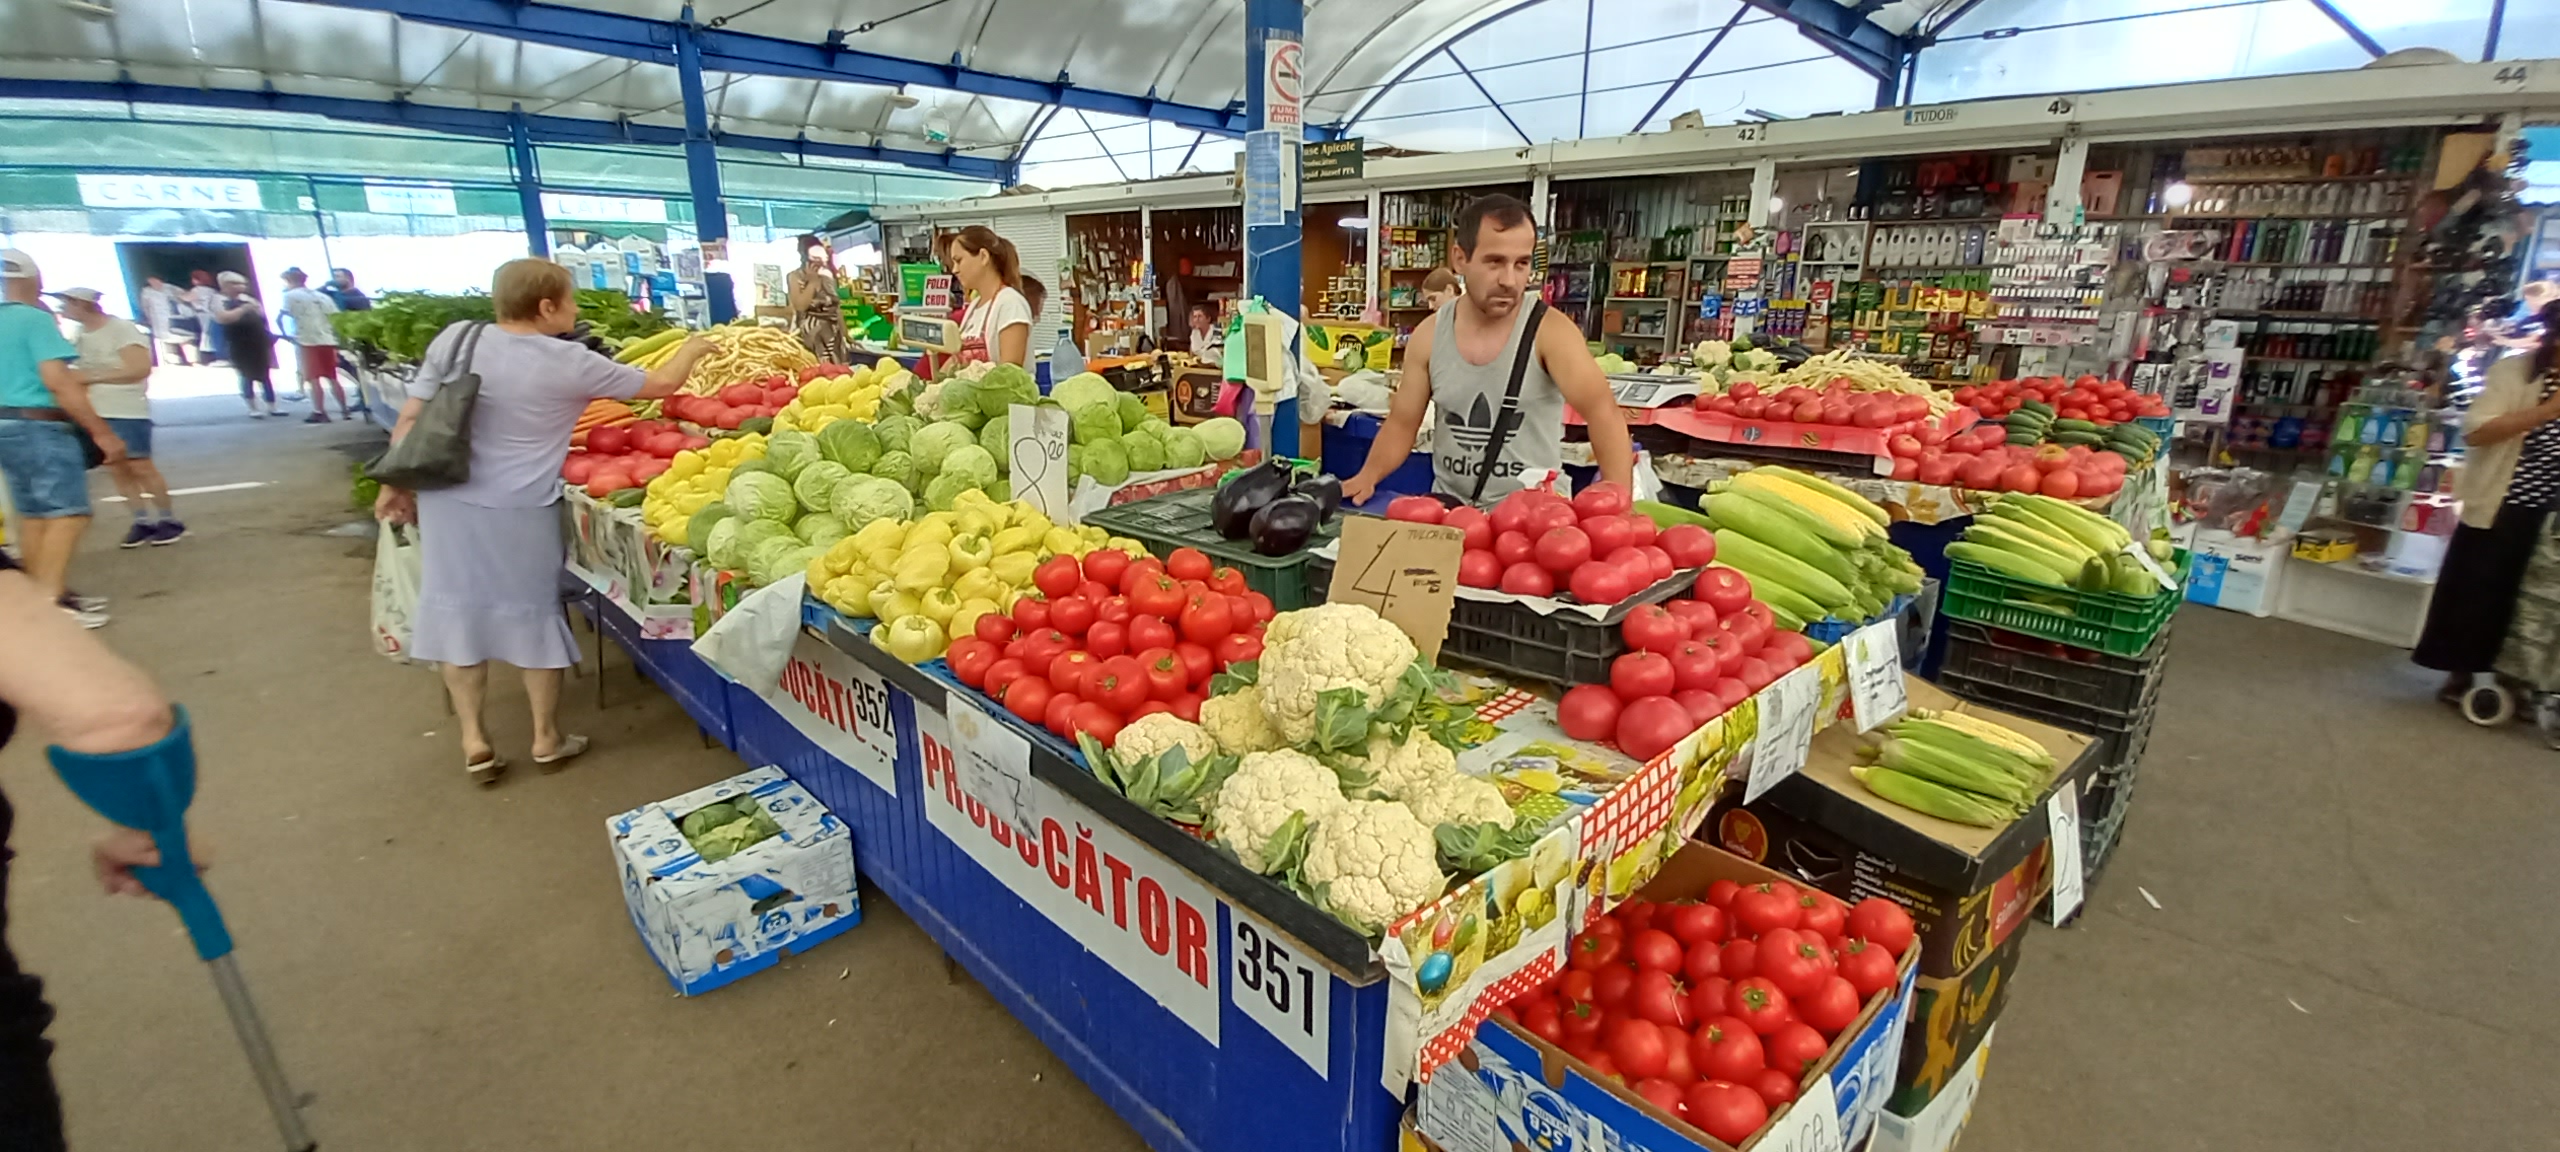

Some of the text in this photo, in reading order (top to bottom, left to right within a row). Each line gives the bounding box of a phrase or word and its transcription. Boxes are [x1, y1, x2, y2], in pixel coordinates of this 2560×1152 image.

[2493, 66, 2527, 84] 44
[1913, 110, 1954, 123] TUDOR
[1738, 128, 1755, 141] 42
[1321, 141, 1356, 157] Apicole
[99, 183, 243, 203] CARNE
[926, 278, 950, 290] POLEN
[925, 294, 946, 306] CRUD
[1351, 529, 1398, 619] 4
[851, 677, 894, 738] 352
[1237, 919, 1314, 1038] 351
[1529, 1112, 1564, 1147] SCB
